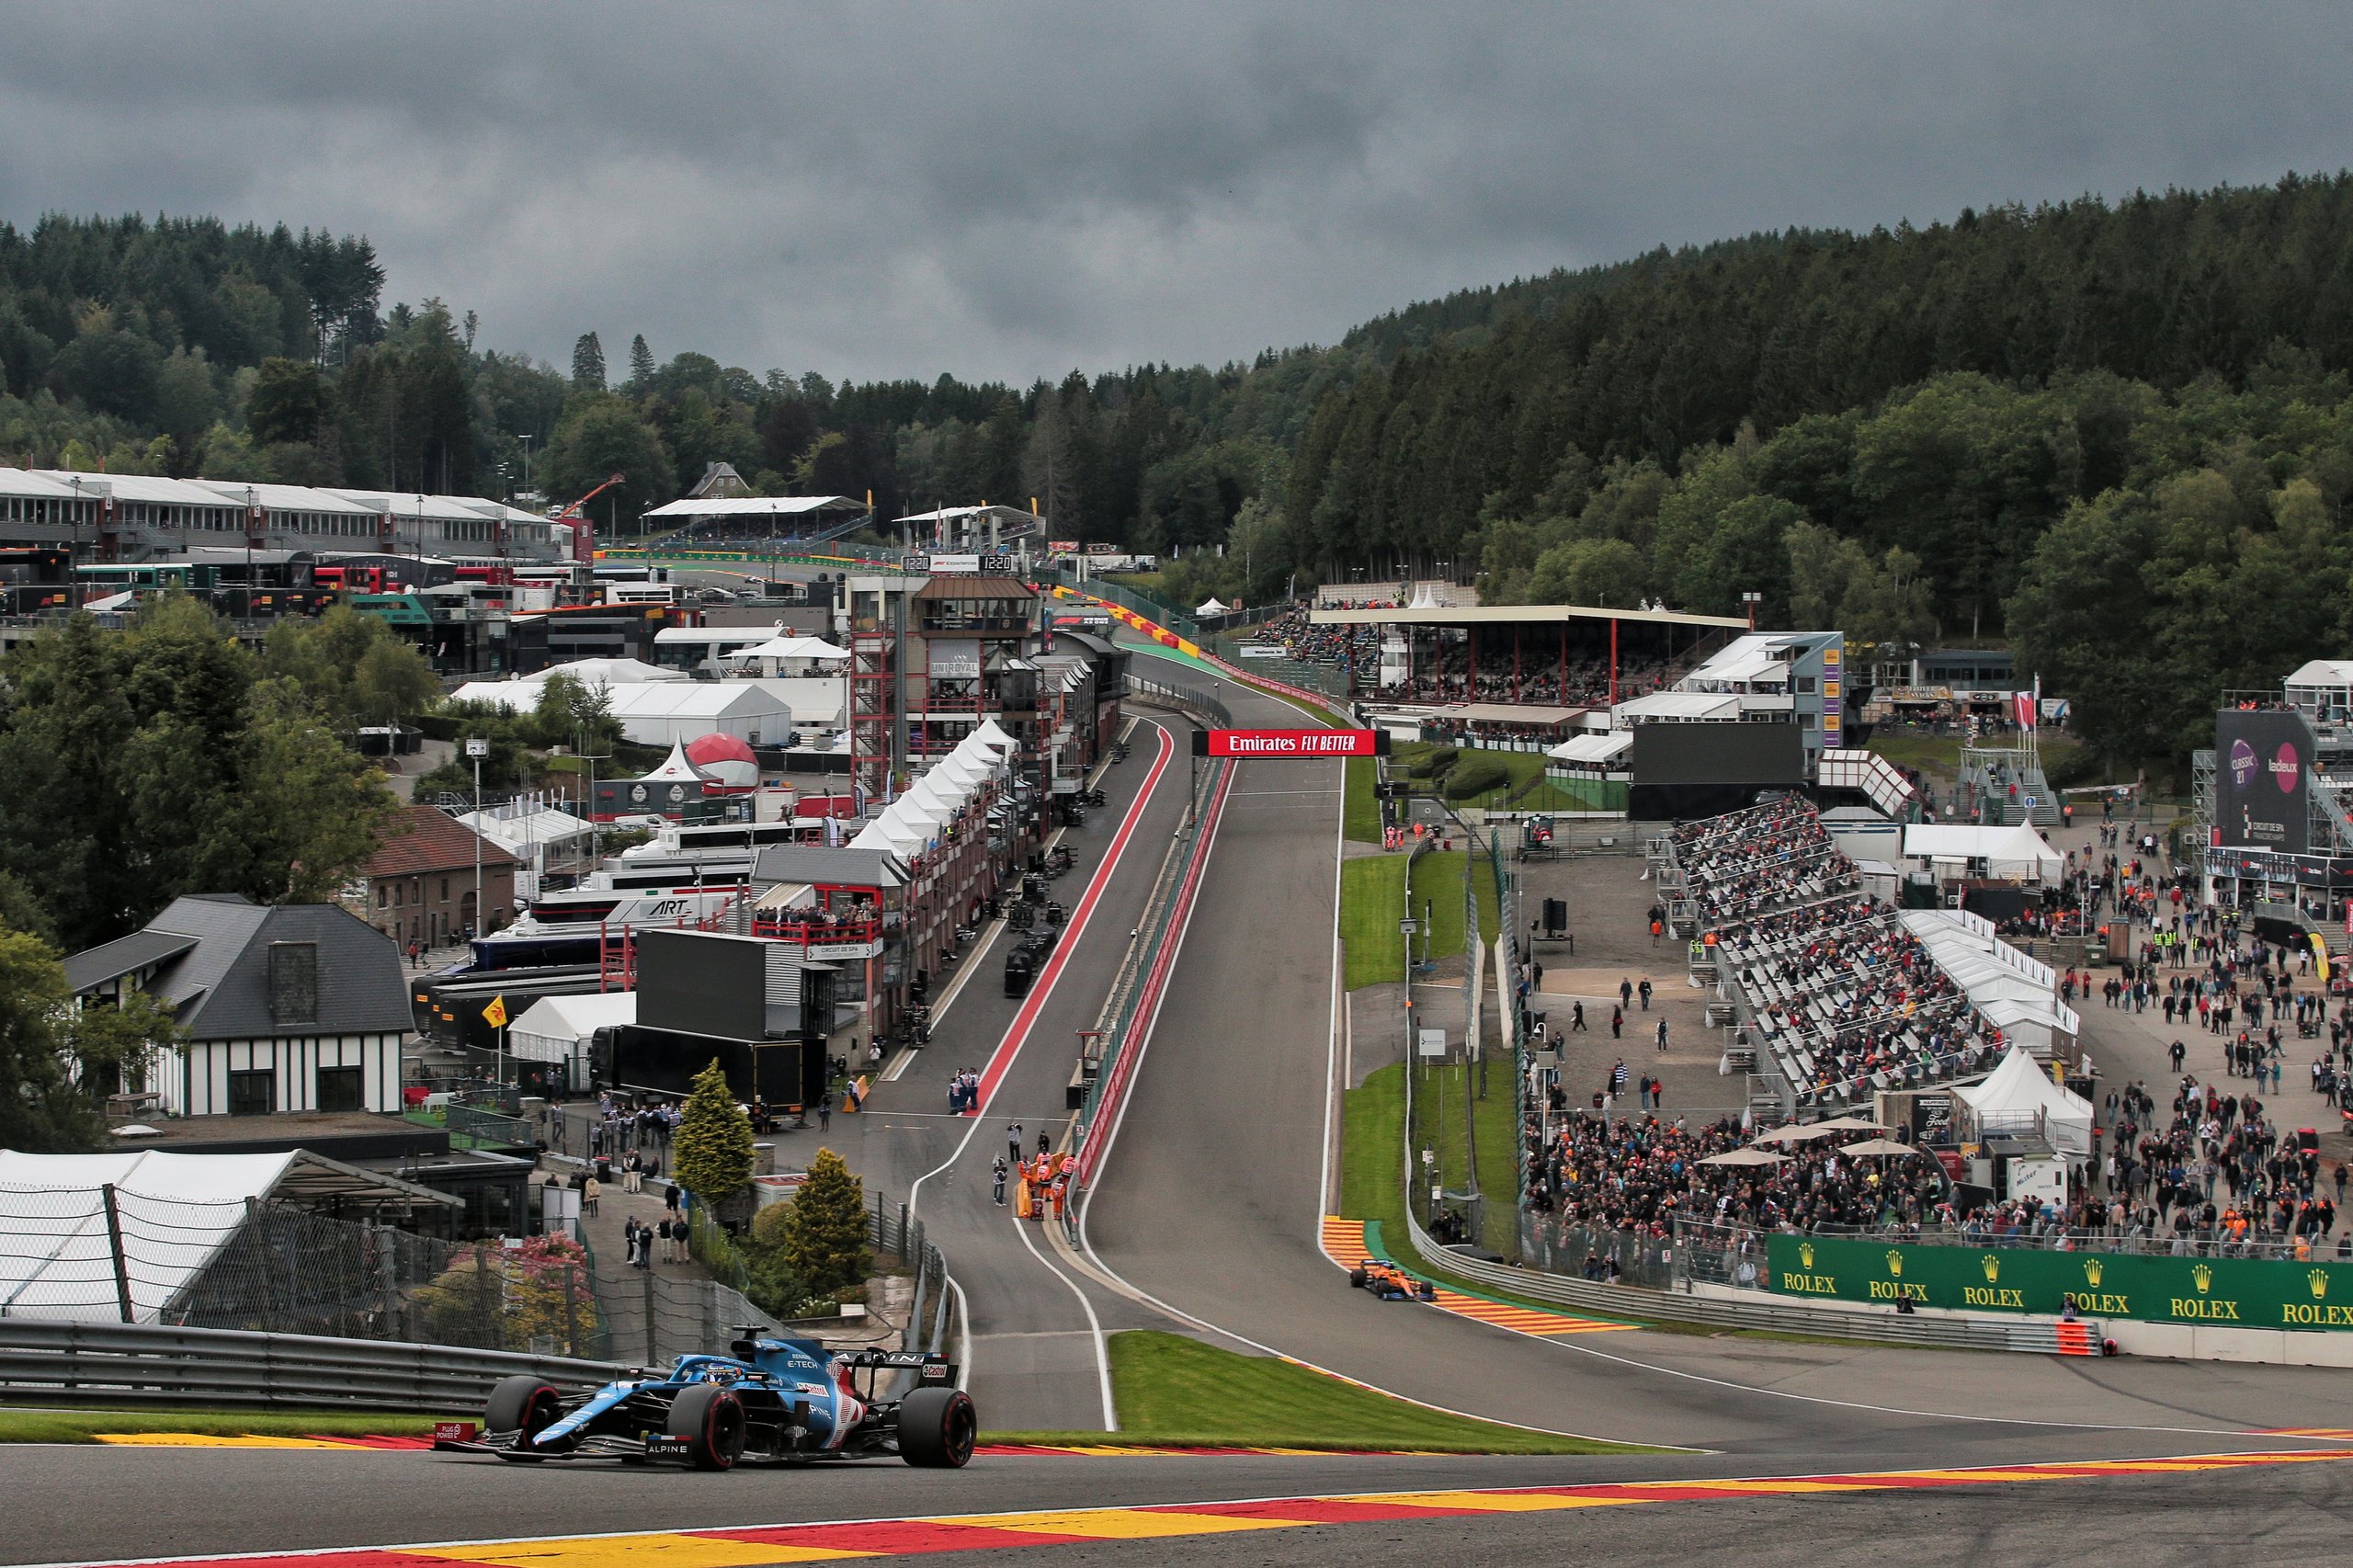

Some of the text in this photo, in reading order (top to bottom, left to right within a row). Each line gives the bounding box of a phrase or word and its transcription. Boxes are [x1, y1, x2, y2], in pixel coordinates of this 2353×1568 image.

[906, 557, 928, 570] 12:20
[984, 557, 1011, 569] 12:20
[931, 663, 977, 673] UNIROYAL
[1229, 735, 1355, 751] Emirates FLY BETTER
[2232, 756, 2254, 770] CLASSIC
[2268, 758, 2298, 773] ladeux
[2236, 770, 2245, 784] 21
[649, 900, 688, 915] ART
[1926, 1114, 1950, 1127] Food
[1783, 1272, 1837, 1294] ROLEX
[1963, 1287, 2024, 1307] ROLEX
[2170, 1298, 2240, 1319] ROLEX
[2281, 1303, 2353, 1324] ROLEX
[928, 1365, 946, 1377] Castrol
